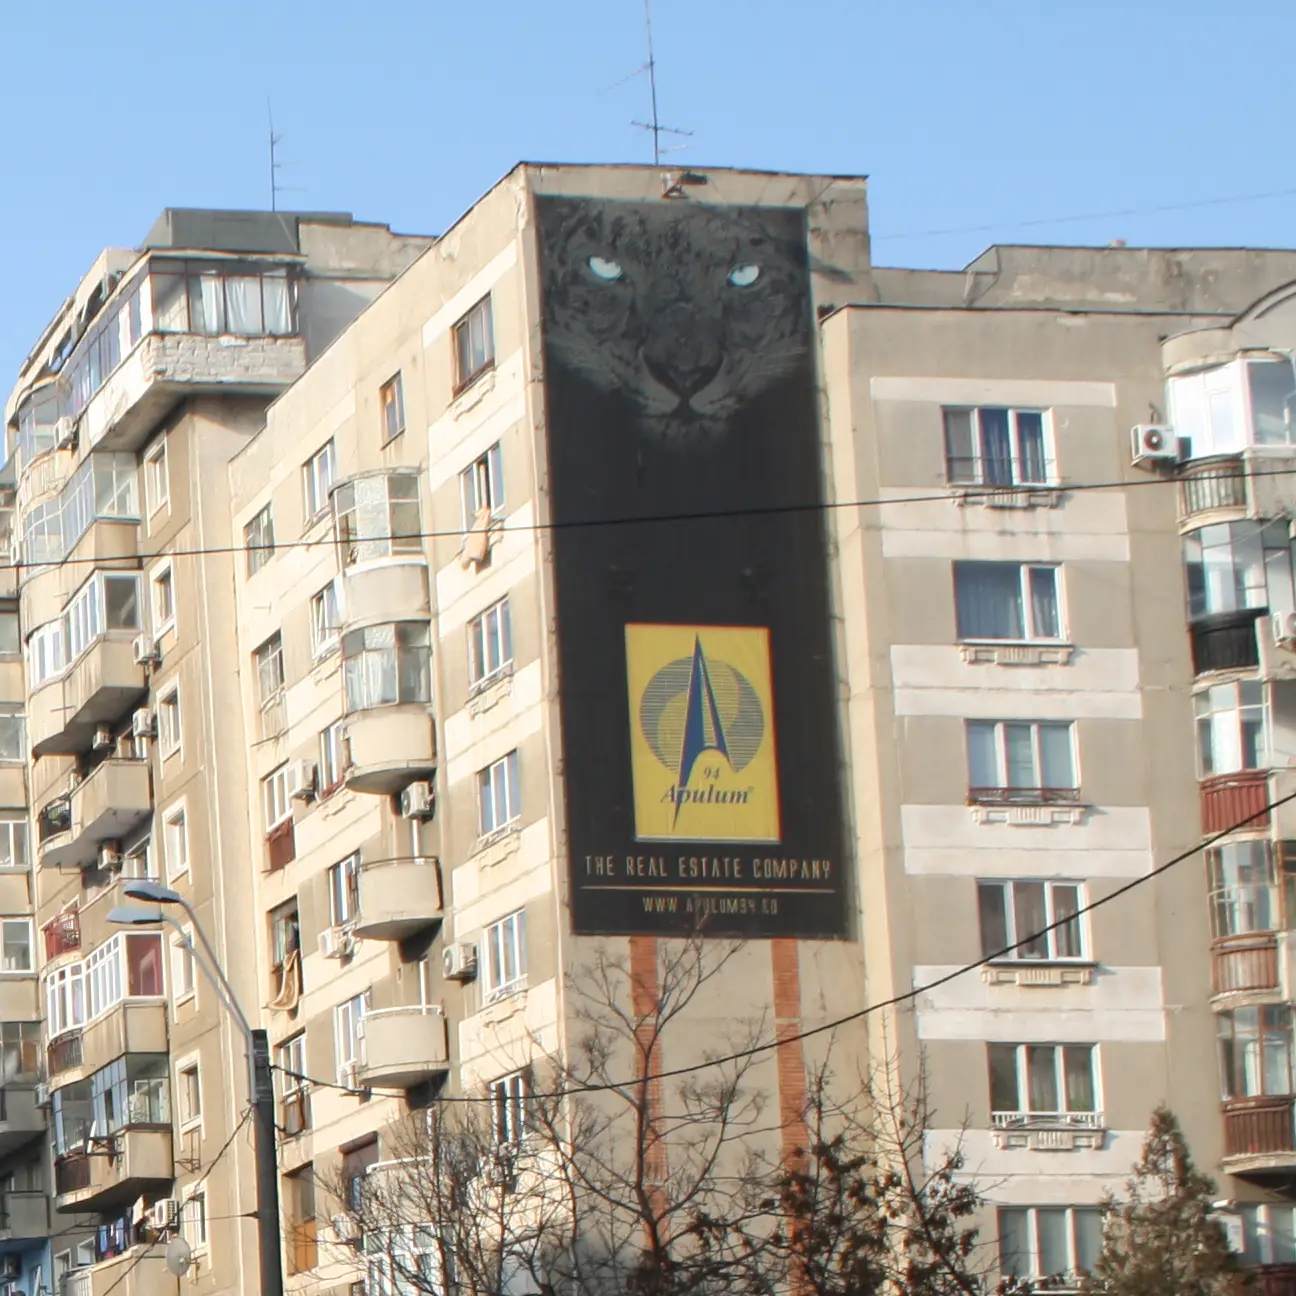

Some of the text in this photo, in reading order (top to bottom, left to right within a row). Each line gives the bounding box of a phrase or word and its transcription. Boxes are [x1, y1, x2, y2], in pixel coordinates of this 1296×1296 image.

[703, 766, 721, 780] 94
[659, 783, 749, 804] Apulum
[585, 855, 831, 879] THE REAL ESTATE COMPANY
